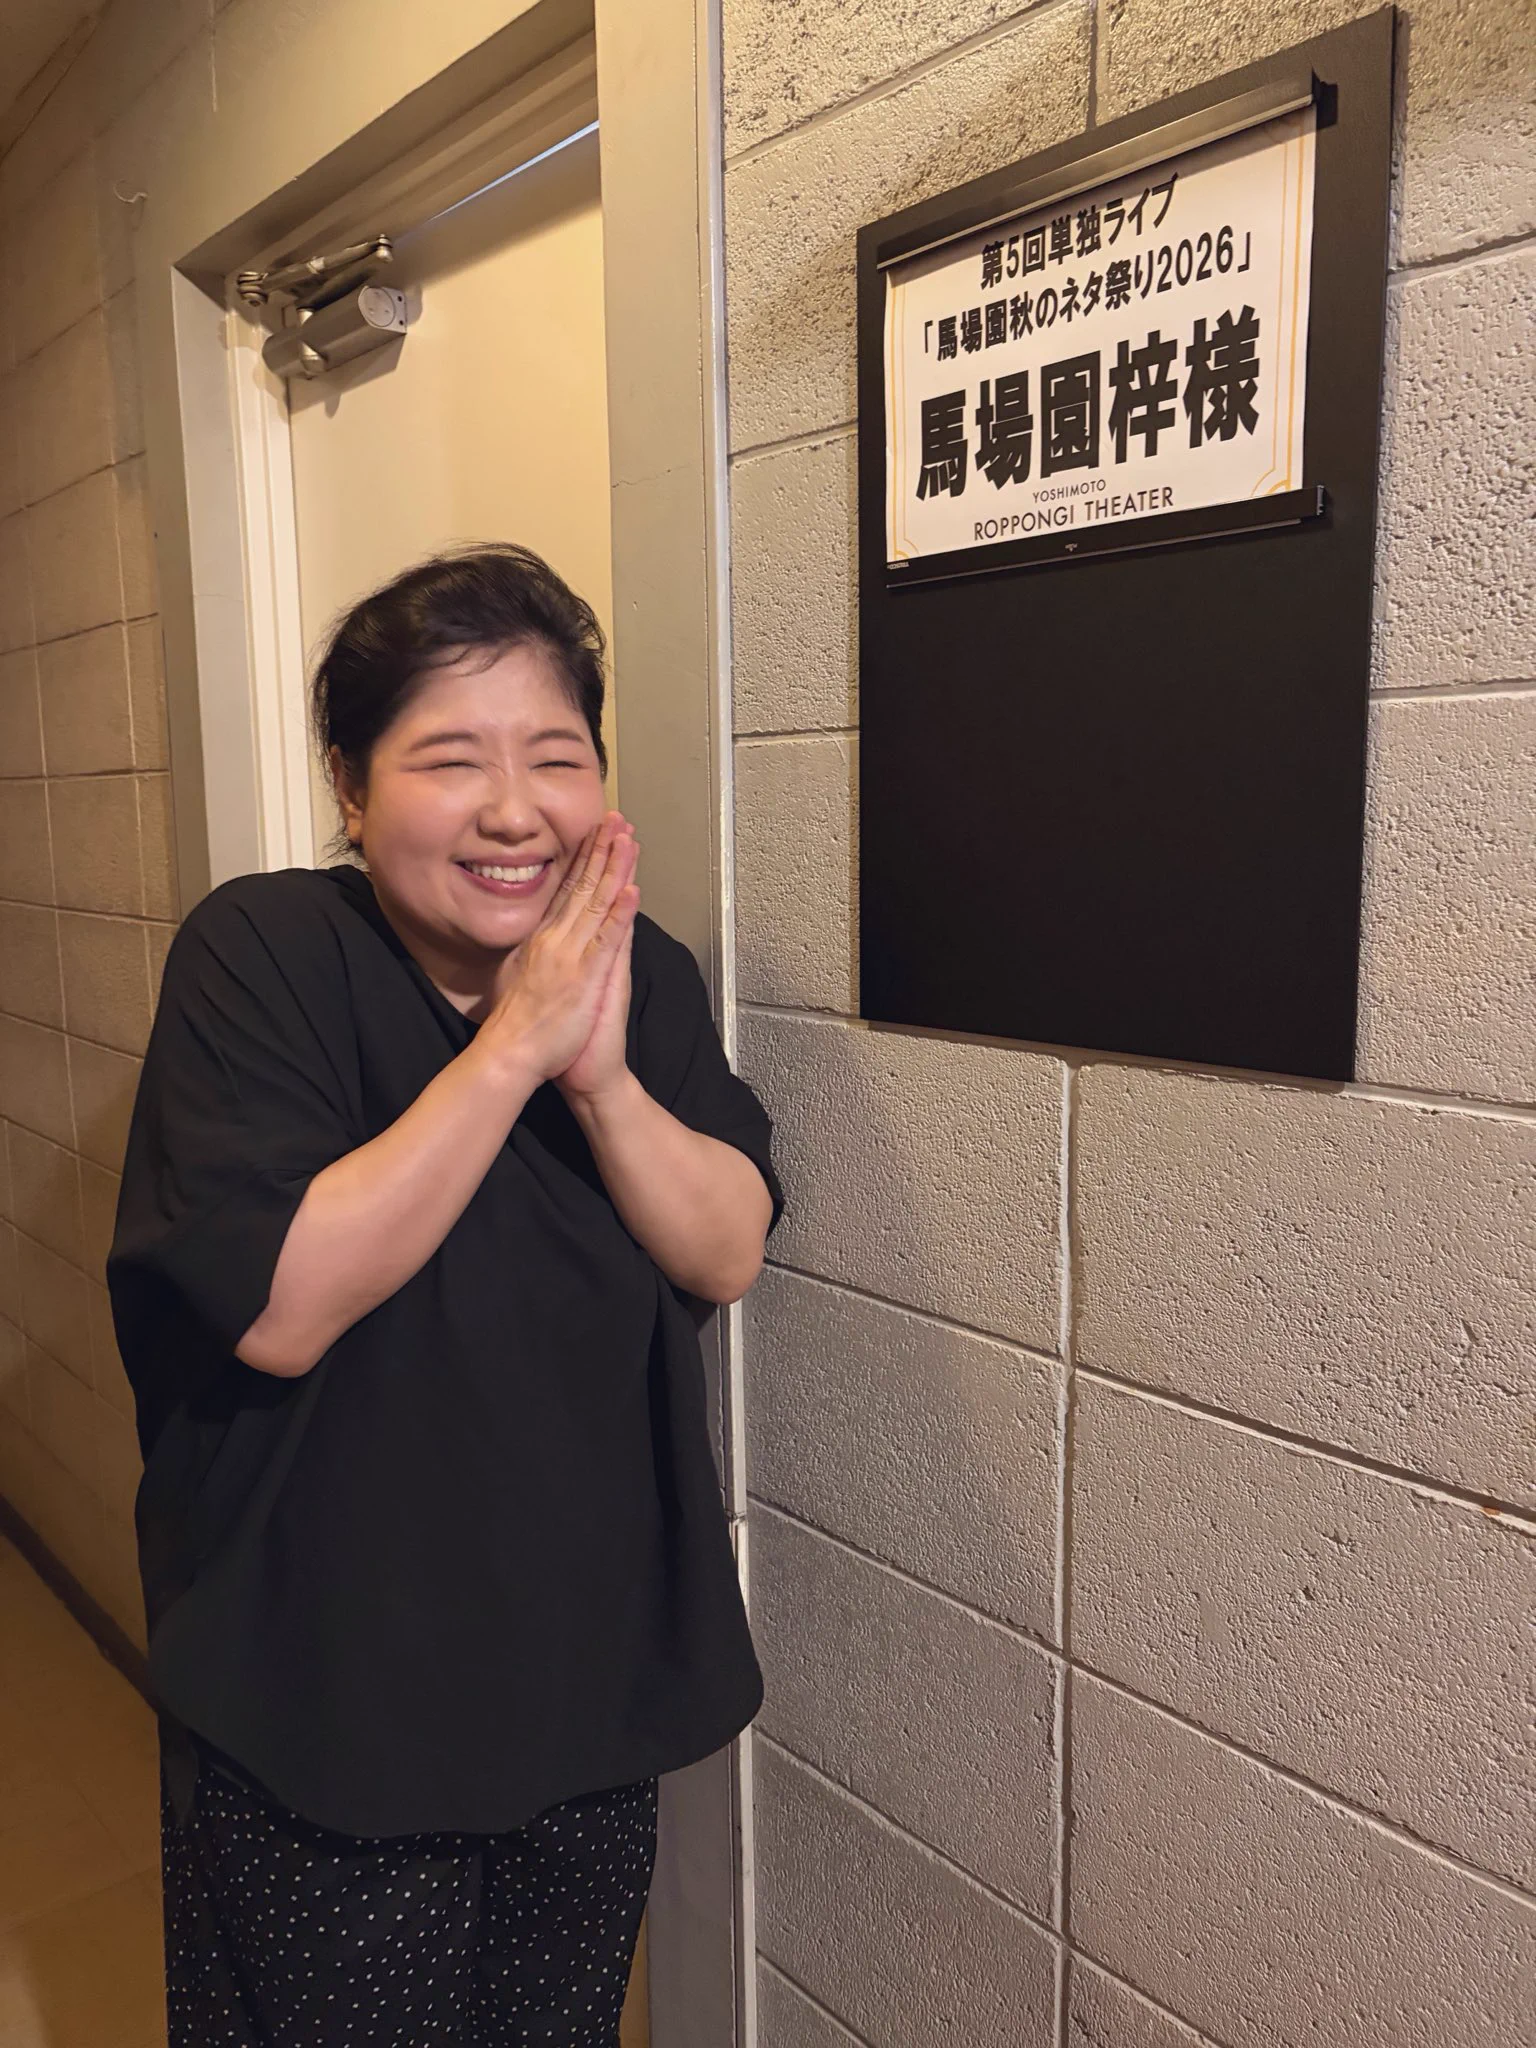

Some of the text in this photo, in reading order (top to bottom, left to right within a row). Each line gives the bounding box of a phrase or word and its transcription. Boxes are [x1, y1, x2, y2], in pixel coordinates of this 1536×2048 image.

[980, 172, 1178, 290] 第5回単独ライブ
[924, 225, 1252, 362] 「馬場園秋のネタ祭り2026」
[915, 304, 1261, 502] 馬場園梓様
[974, 486, 1174, 541] ROPPONGI THEATER
[1032, 479, 1106, 504] YOSHIMOTO
